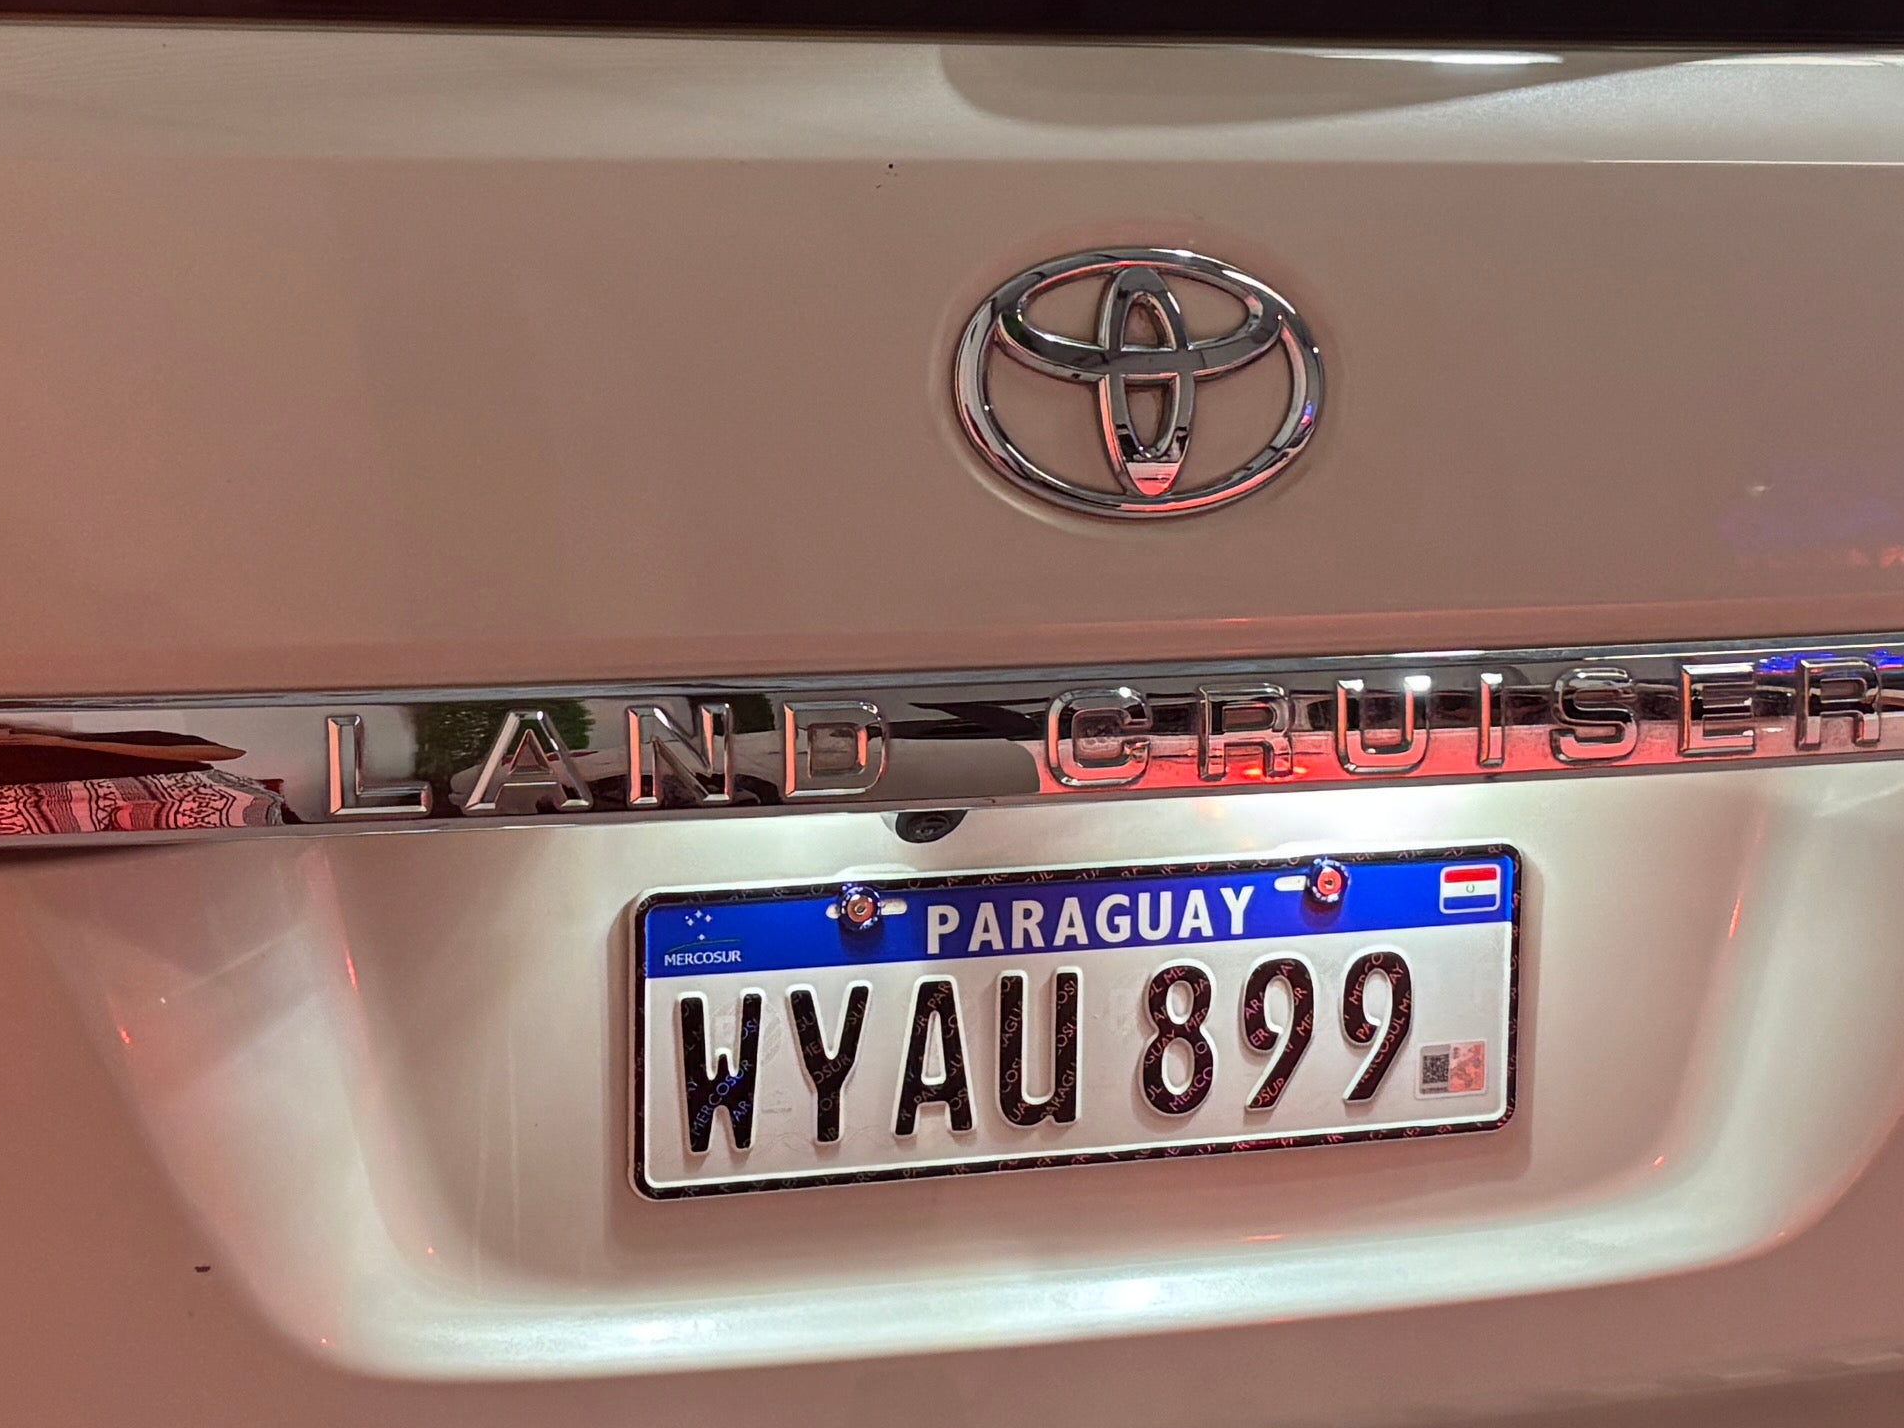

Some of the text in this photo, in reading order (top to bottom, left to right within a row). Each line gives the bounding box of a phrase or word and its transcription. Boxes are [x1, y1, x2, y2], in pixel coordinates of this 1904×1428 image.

[326, 657, 1882, 817] LAND CRUISER
[664, 950, 742, 967] MERCOSUR
[927, 885, 1256, 955] PARAGUAY
[679, 945, 1414, 1154] WYAU 899
